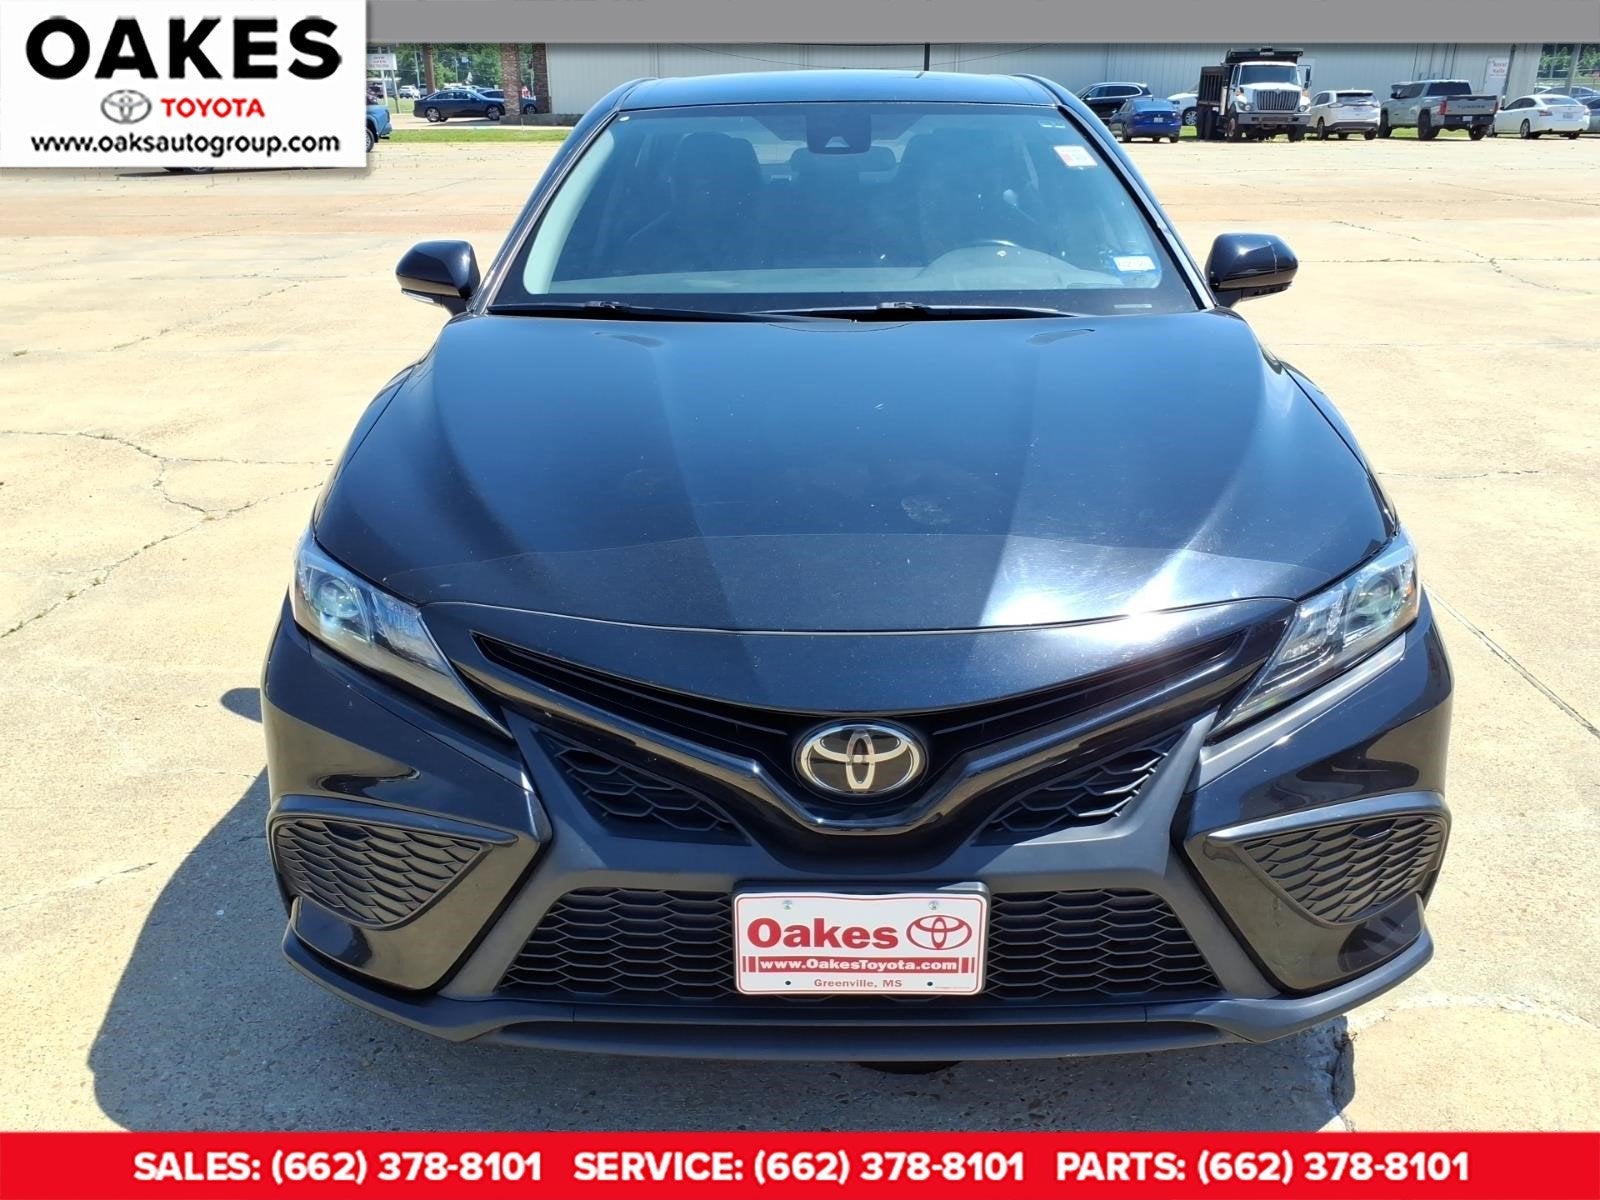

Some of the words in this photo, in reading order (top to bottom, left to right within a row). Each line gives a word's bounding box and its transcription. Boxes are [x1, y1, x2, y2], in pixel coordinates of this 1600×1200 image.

[747, 917, 899, 950] Oakes
[760, 958, 957, 972] www.OakesToyota.com
[814, 978, 877, 988] Greenville,
[882, 979, 903, 988] MS
